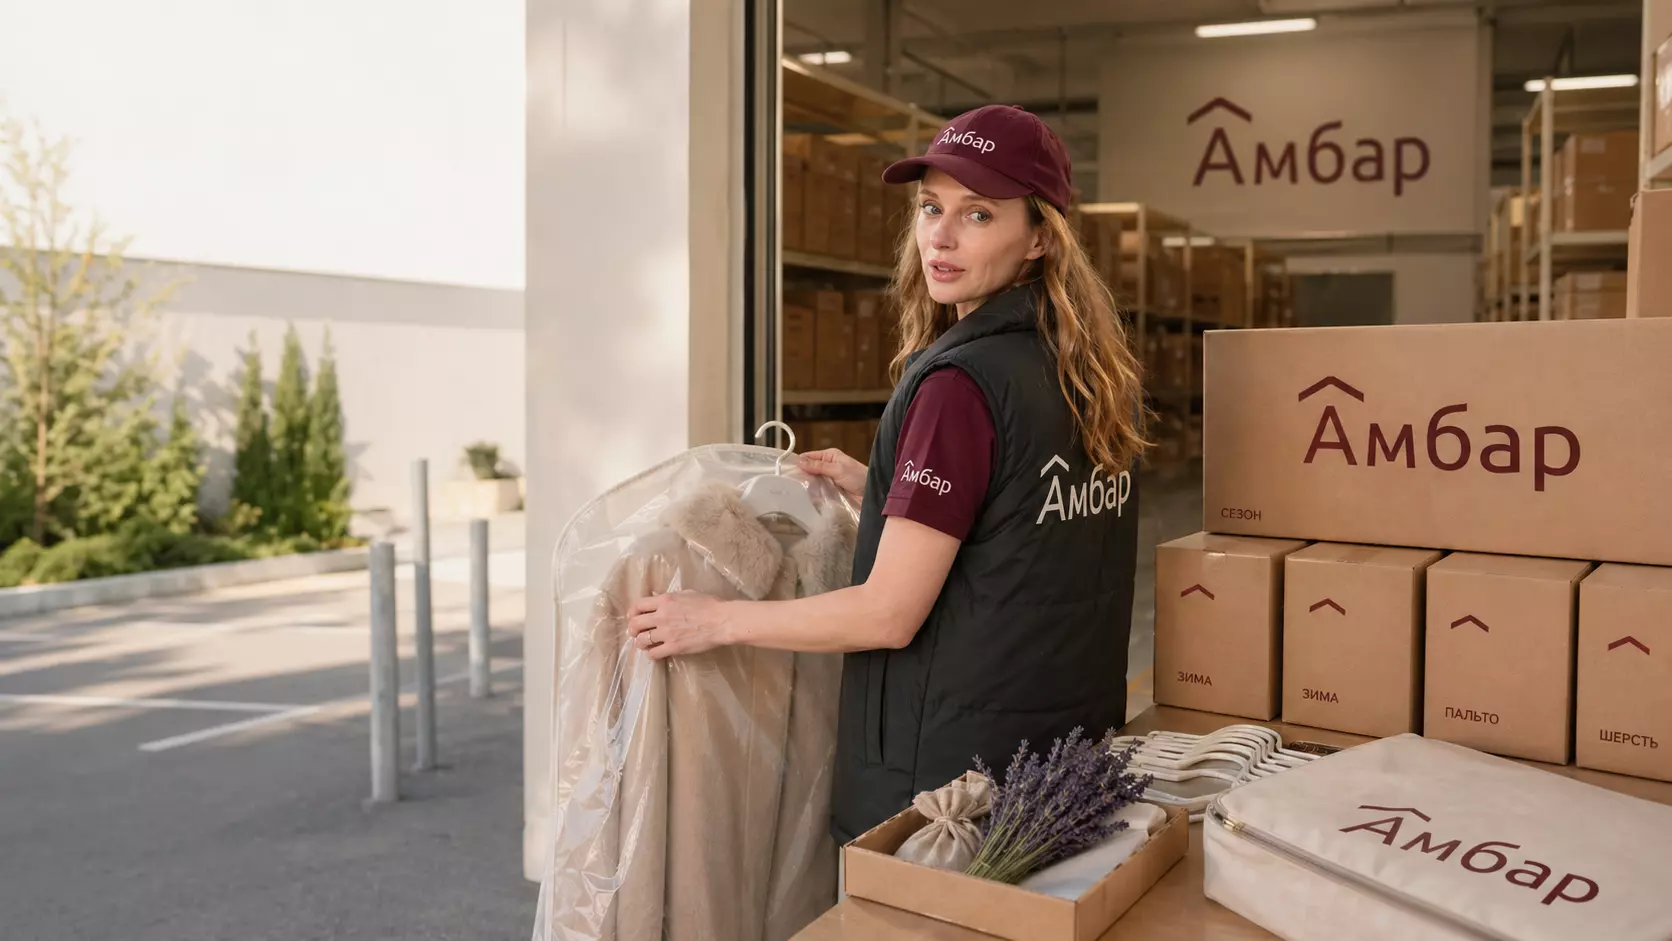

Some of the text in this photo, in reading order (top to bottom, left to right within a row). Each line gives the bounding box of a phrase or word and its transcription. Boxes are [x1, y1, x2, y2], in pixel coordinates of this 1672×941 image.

[936, 131, 996, 154] Амбар
[1192, 120, 1431, 198] Амбар
[1303, 402, 1581, 493] Амбар
[900, 465, 952, 496] Амбар
[1036, 463, 1131, 525] Амбар
[1221, 507, 1262, 522] СЕЗОН
[1176, 670, 1213, 687] ЗИМА
[1302, 688, 1340, 704] ЗИМА
[1444, 706, 1500, 726] ПАЛЬТО
[1599, 729, 1659, 749] ШЕРСТЬ
[1338, 816, 1600, 906] Амбар
